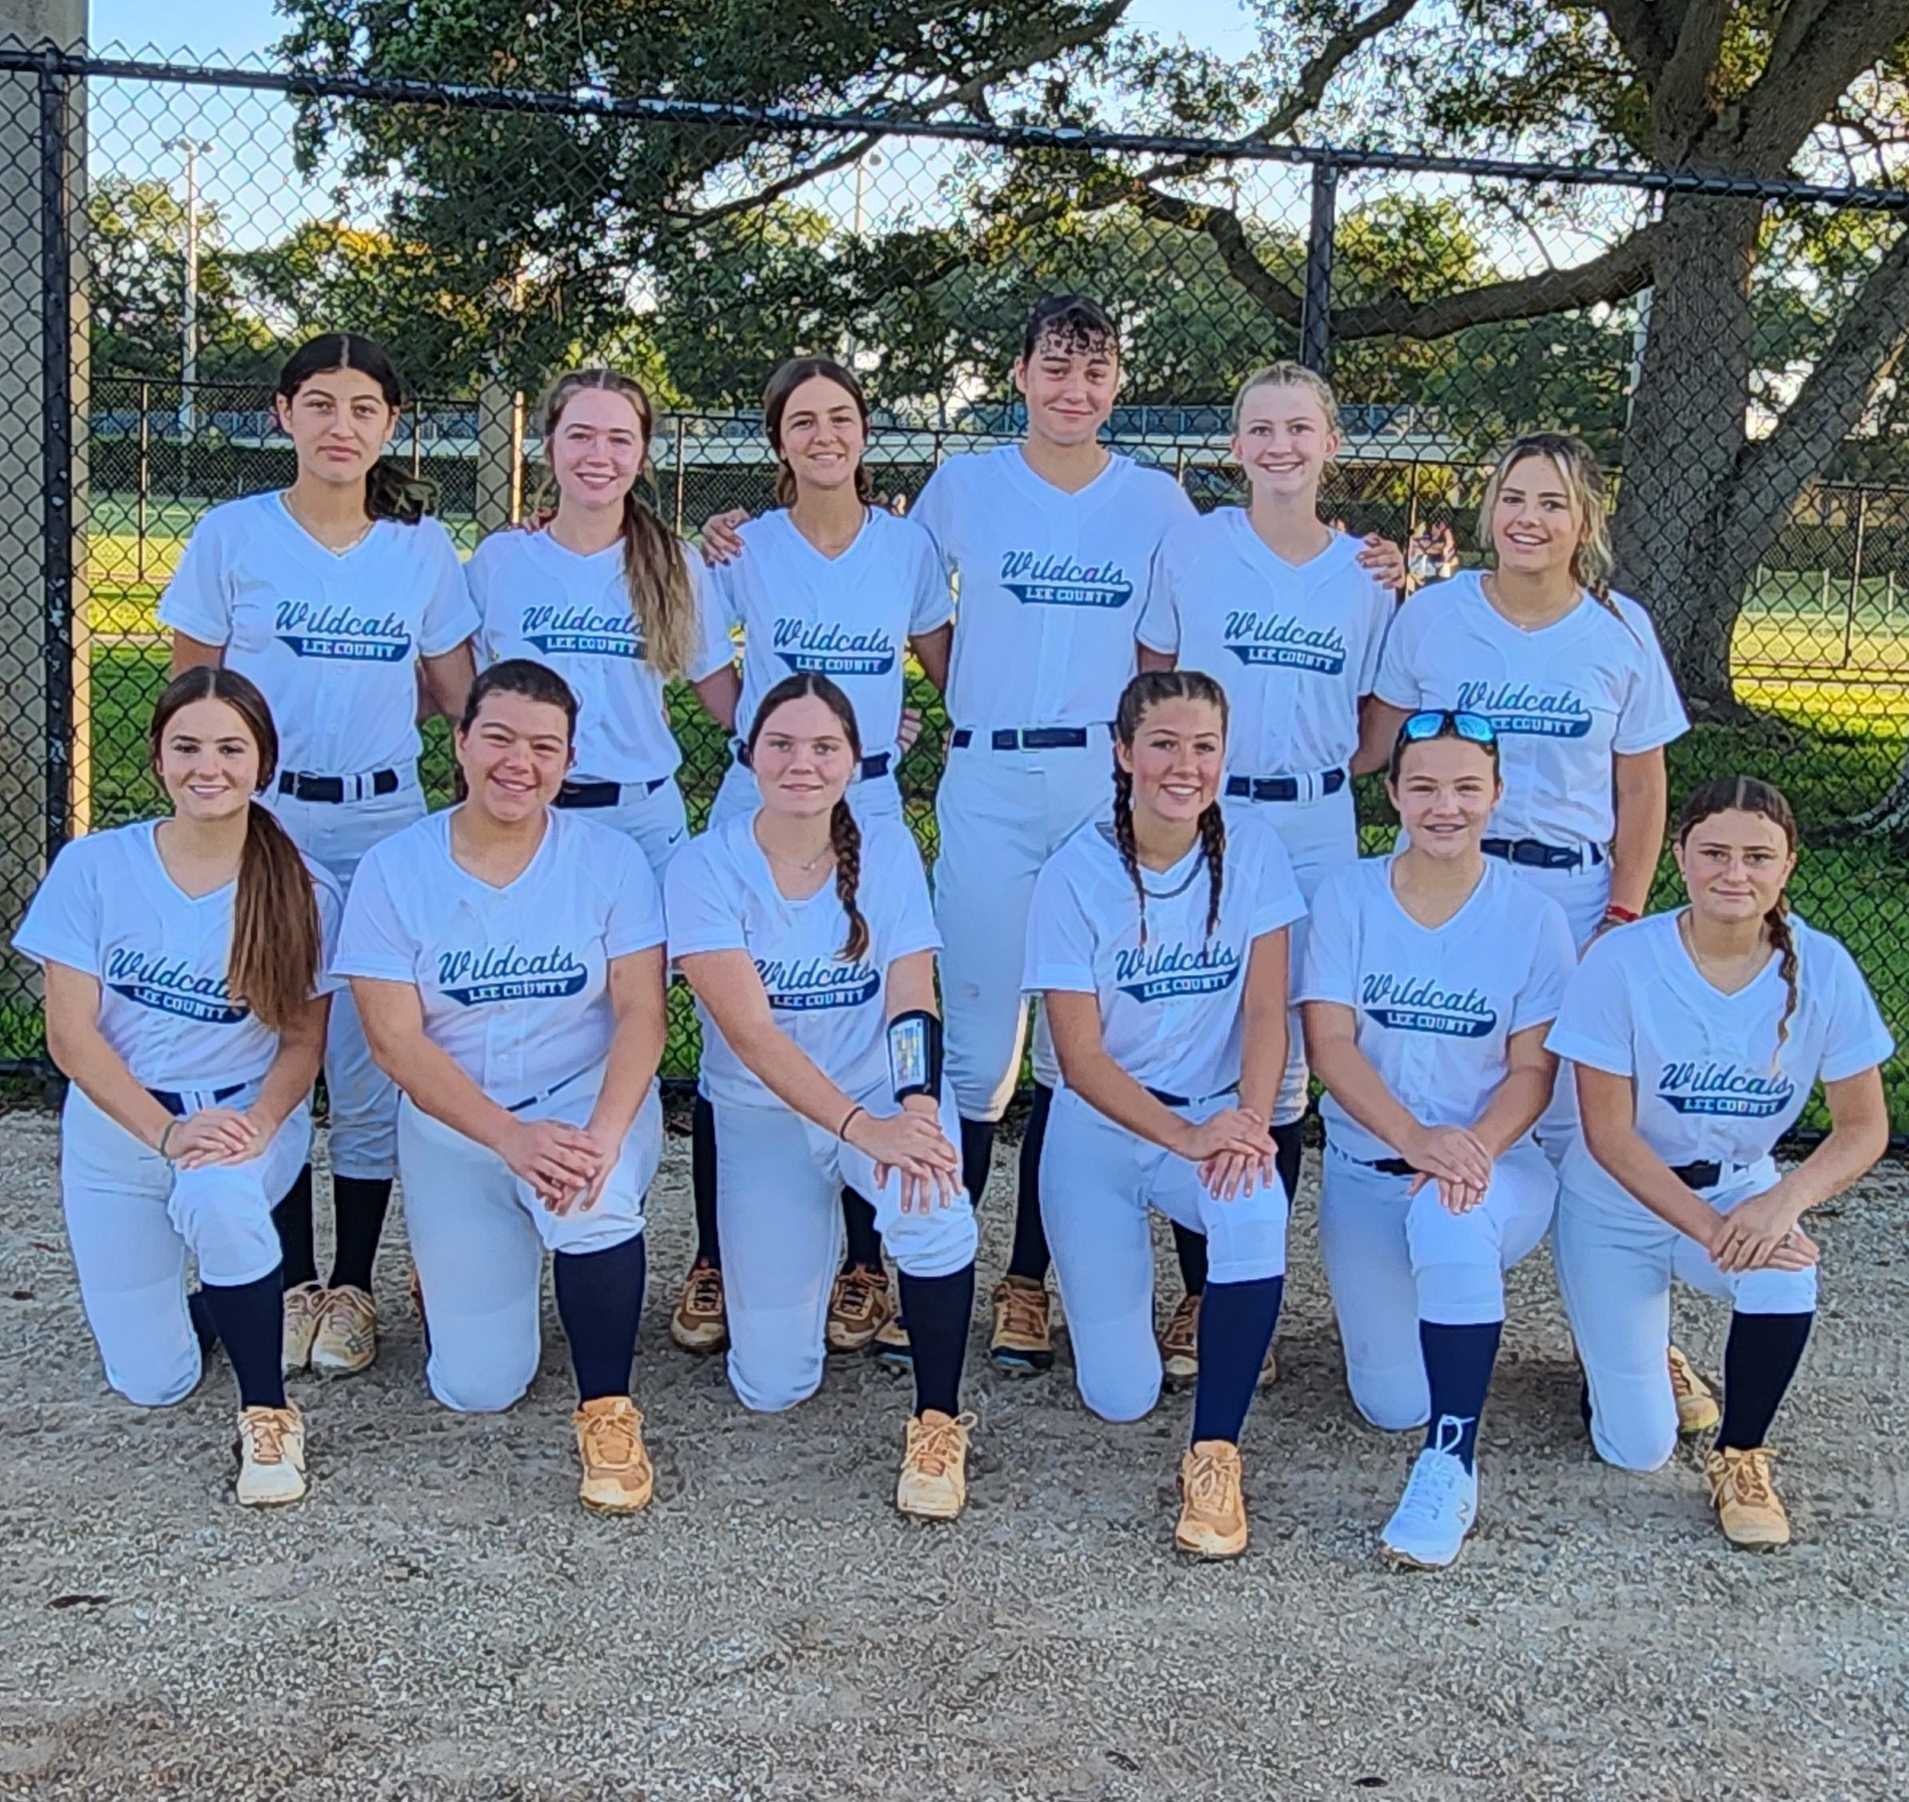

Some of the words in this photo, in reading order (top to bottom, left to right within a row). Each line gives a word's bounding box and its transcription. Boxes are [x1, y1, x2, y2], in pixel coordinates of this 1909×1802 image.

[1001, 550, 1126, 585] Wildcats
[1026, 587, 1054, 600] LEE
[1056, 589, 1115, 604] COUNTY
[275, 600, 407, 638] Wildcats
[1224, 611, 1345, 651] Wildcats
[546, 637, 576, 650] LEE
[578, 638, 638, 654] COUNTY
[773, 617, 892, 652] Wildcats
[302, 639, 332, 655] LEE
[334, 642, 396, 658] COUNTY
[1248, 648, 1276, 662] LEE
[1278, 649, 1335, 671] COUNTY
[796, 656, 823, 670] LEE
[825, 658, 882, 673] COUNTY
[1457, 681, 1586, 714] Wildcats
[1490, 717, 1511, 730] EE
[1512, 718, 1575, 734] COUNTY
[438, 945, 576, 984] Wildcats
[754, 957, 872, 991] Wildcats
[1115, 940, 1238, 981] Wildcats
[468, 986, 500, 1002] LEE
[503, 980, 569, 997] COUNTY
[773, 996, 803, 1008] LEE
[805, 988, 864, 1007] COUNTY
[1144, 981, 1171, 997] LEE
[1172, 974, 1231, 993] COUNTY
[1363, 973, 1491, 1015] Wildcats
[134, 988, 161, 1005] LEE
[163, 995, 229, 1020] COUNTY
[1386, 1012, 1415, 1026] LEE
[1416, 1014, 1477, 1034] COUNTY
[1659, 1062, 1791, 1096] Wildcats
[1683, 1098, 1715, 1111] LEE
[1717, 1099, 1779, 1114] COUNTY
